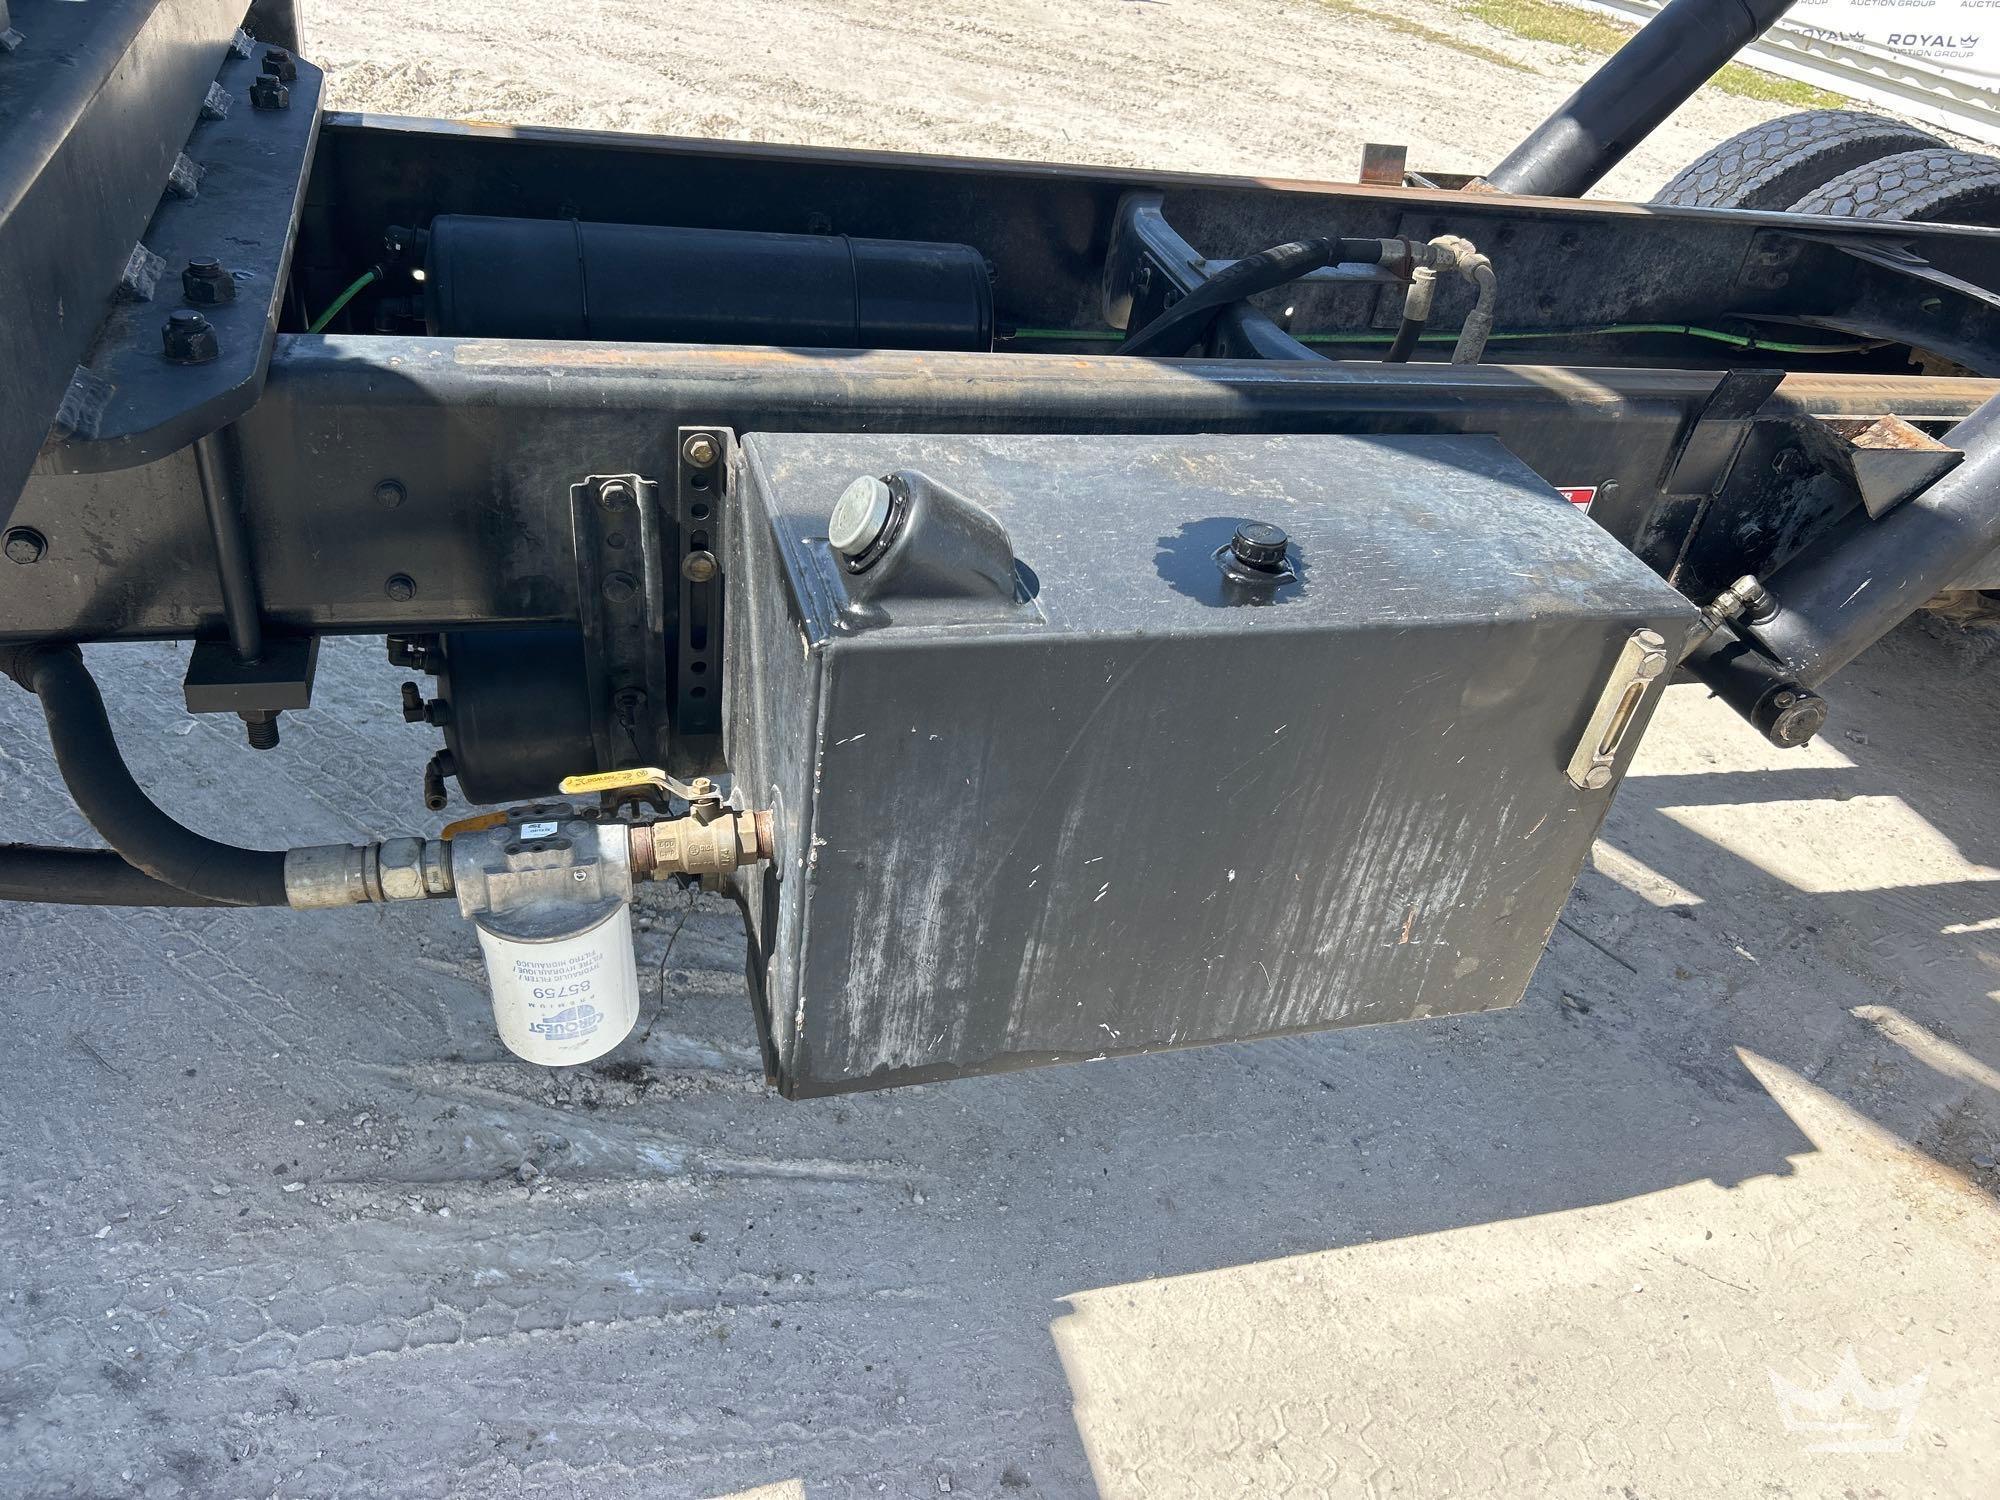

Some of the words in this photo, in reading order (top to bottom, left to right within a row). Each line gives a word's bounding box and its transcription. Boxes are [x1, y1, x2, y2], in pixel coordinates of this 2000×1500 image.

[1887, 33, 1957, 48] ROYAL
[1888, 46, 1933, 57] AUCTION
[1934, 49, 1974, 58] GROUP
[569, 950, 596, 964] FILTRO
[579, 952, 603, 968] FILTRE
[518, 964, 576, 975] HYDRAULIQUE
[554, 963, 600, 982] HYDRAULIC
[524, 974, 551, 982] FILTER
[533, 980, 591, 999] 85759
[528, 1011, 605, 1034] CARQUEST
